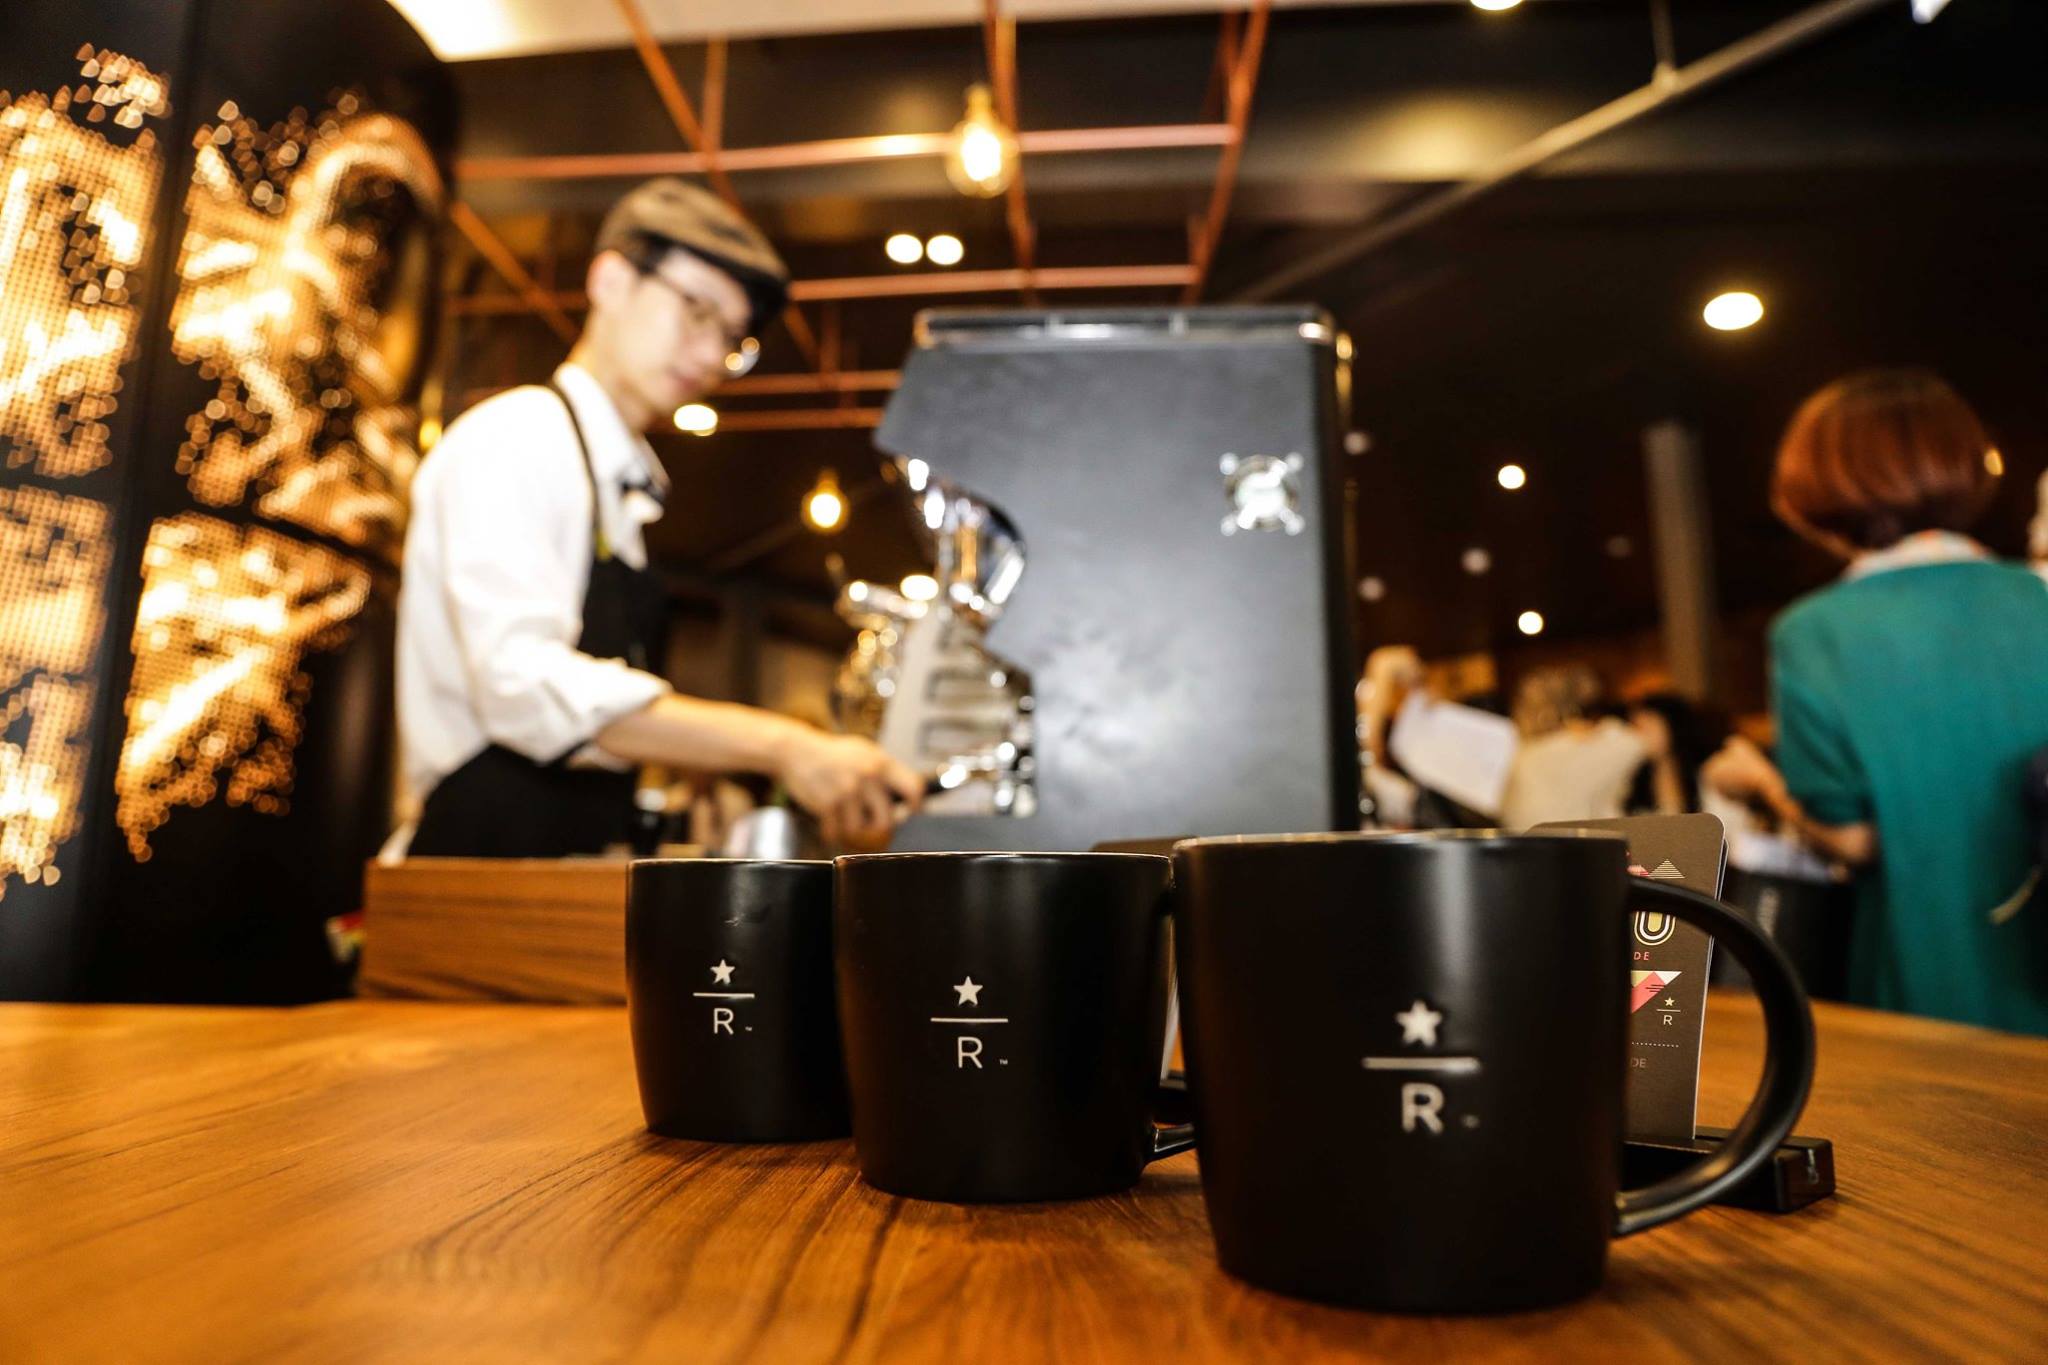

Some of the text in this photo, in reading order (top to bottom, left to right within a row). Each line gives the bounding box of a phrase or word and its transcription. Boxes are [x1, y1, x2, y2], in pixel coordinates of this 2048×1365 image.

[713, 1007, 734, 1035] R
[1663, 1014, 1673, 1026] R
[957, 1036, 983, 1069] R
[1401, 1082, 1444, 1134] R
